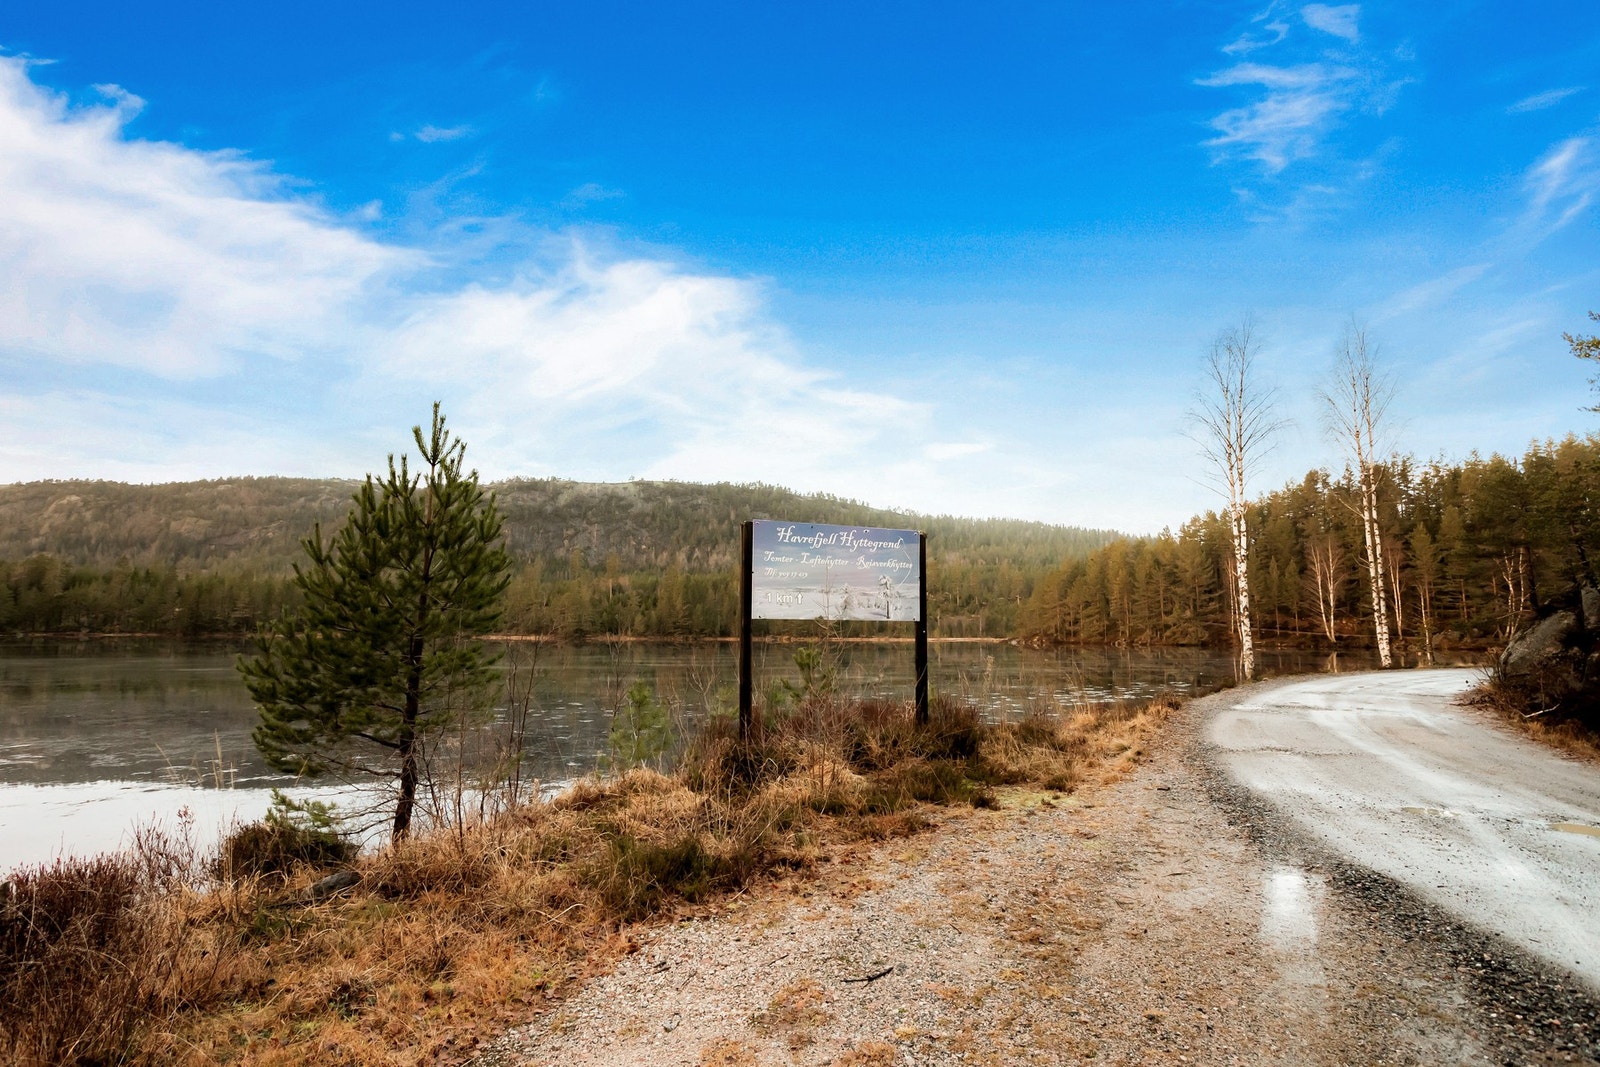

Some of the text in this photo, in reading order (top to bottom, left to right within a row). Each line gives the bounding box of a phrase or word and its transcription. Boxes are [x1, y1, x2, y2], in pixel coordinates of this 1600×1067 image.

[777, 525, 904, 552] Havrefjell Hyttegrend
[764, 551, 794, 563] Tomter
[767, 593, 793, 603] 1 km
